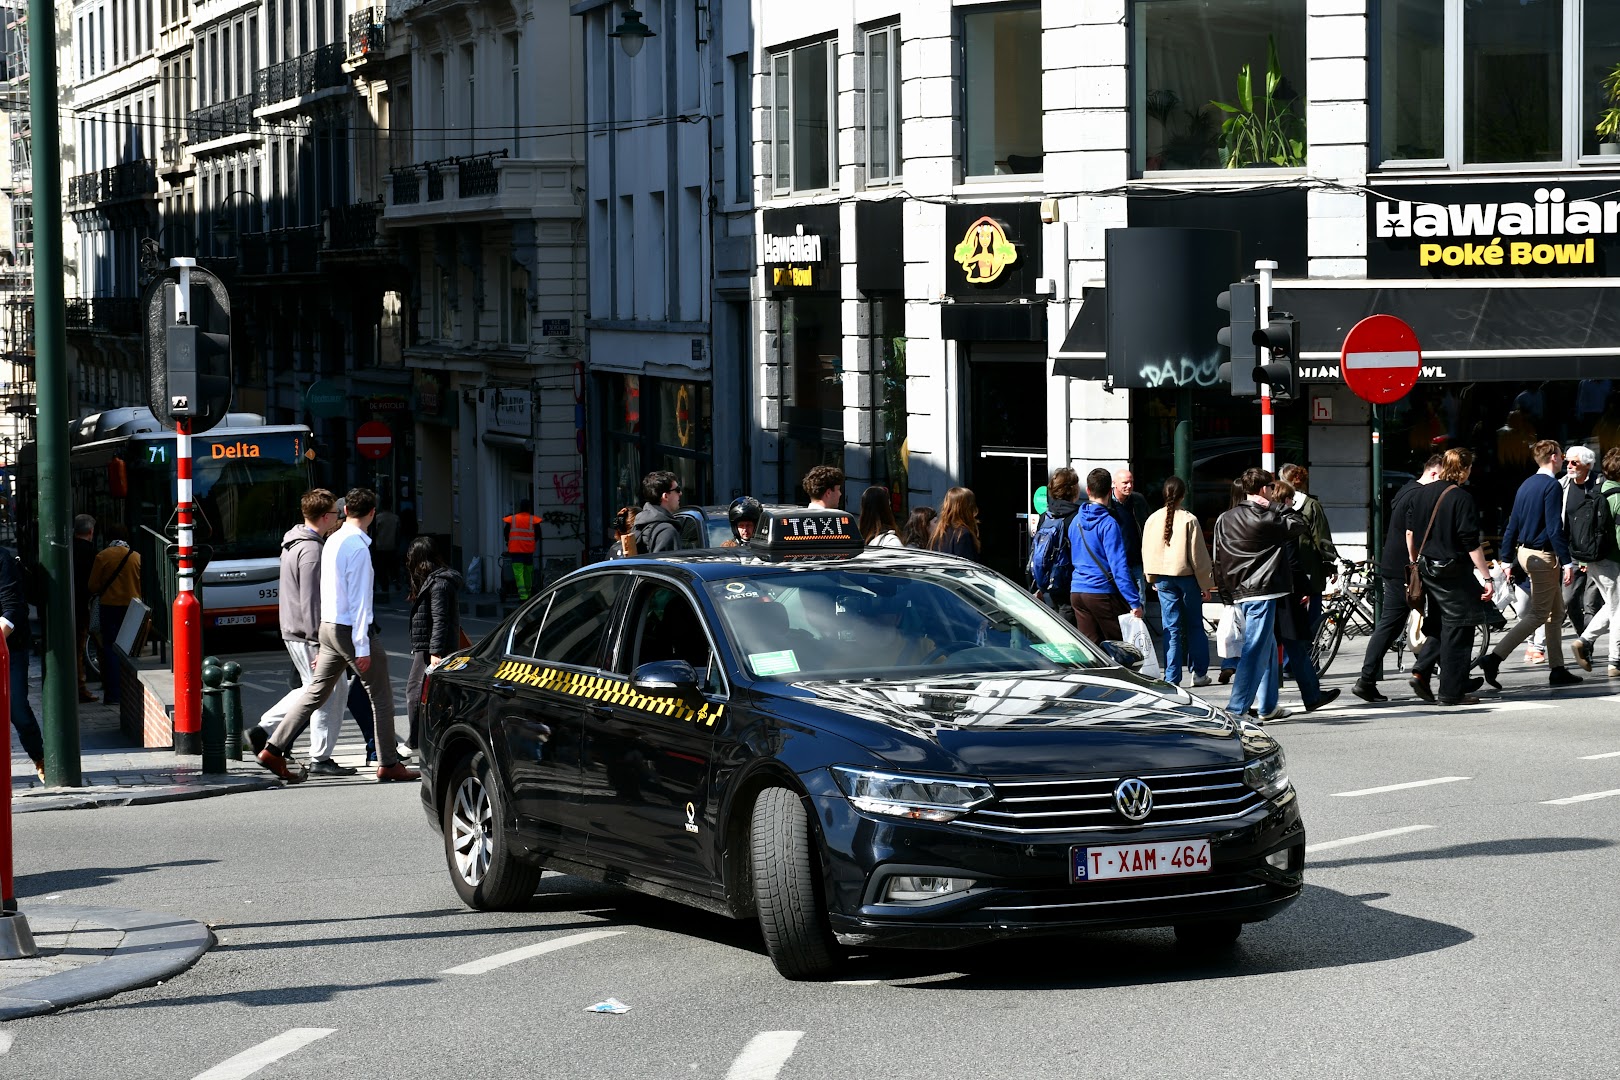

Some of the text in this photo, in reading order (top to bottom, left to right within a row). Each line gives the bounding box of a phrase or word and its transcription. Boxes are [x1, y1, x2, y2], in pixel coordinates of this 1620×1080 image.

[764, 224, 822, 262] Hawaiian
[1420, 237, 1595, 266] Poké Bowl
[793, 265, 812, 286] Bowl
[148, 446, 165, 463] 71
[211, 442, 260, 459] Delta
[788, 517, 842, 535] TAXI
[725, 591, 758, 600] VICTOR
[1077, 866, 1086, 877] B
